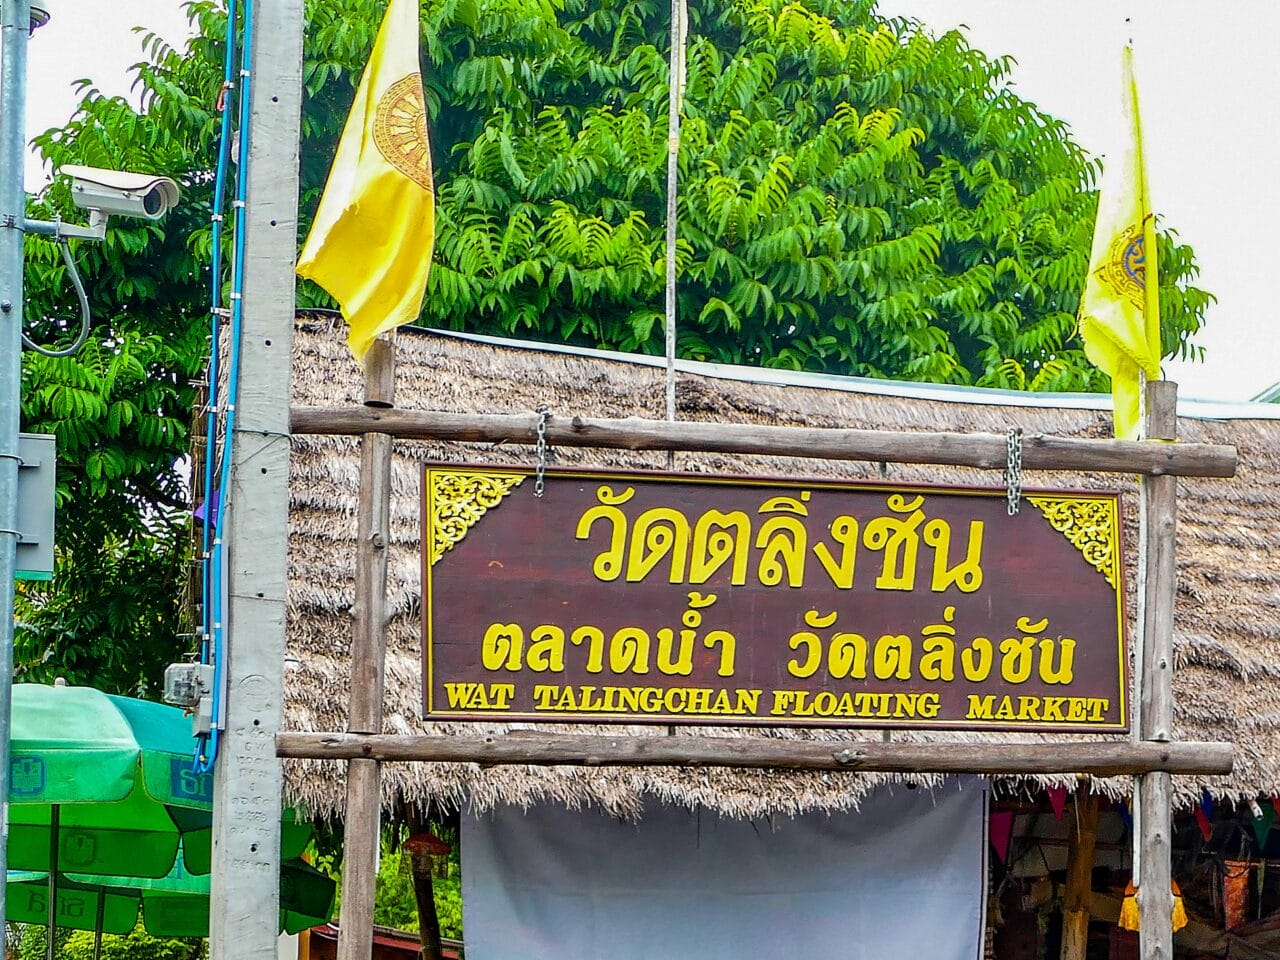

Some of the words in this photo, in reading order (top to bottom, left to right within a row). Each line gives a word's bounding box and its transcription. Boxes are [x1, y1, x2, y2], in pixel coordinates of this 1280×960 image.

[576, 486, 984, 593] วัดตลิ่งชัน
[482, 592, 736, 677] ตลาดน้ำ
[787, 606, 1076, 685] วัดตลิ่งชัน
[444, 683, 515, 710] WAT
[534, 685, 764, 716] TALINGCHAN
[770, 690, 941, 719] FLOATING
[966, 694, 1109, 722] MARKET
